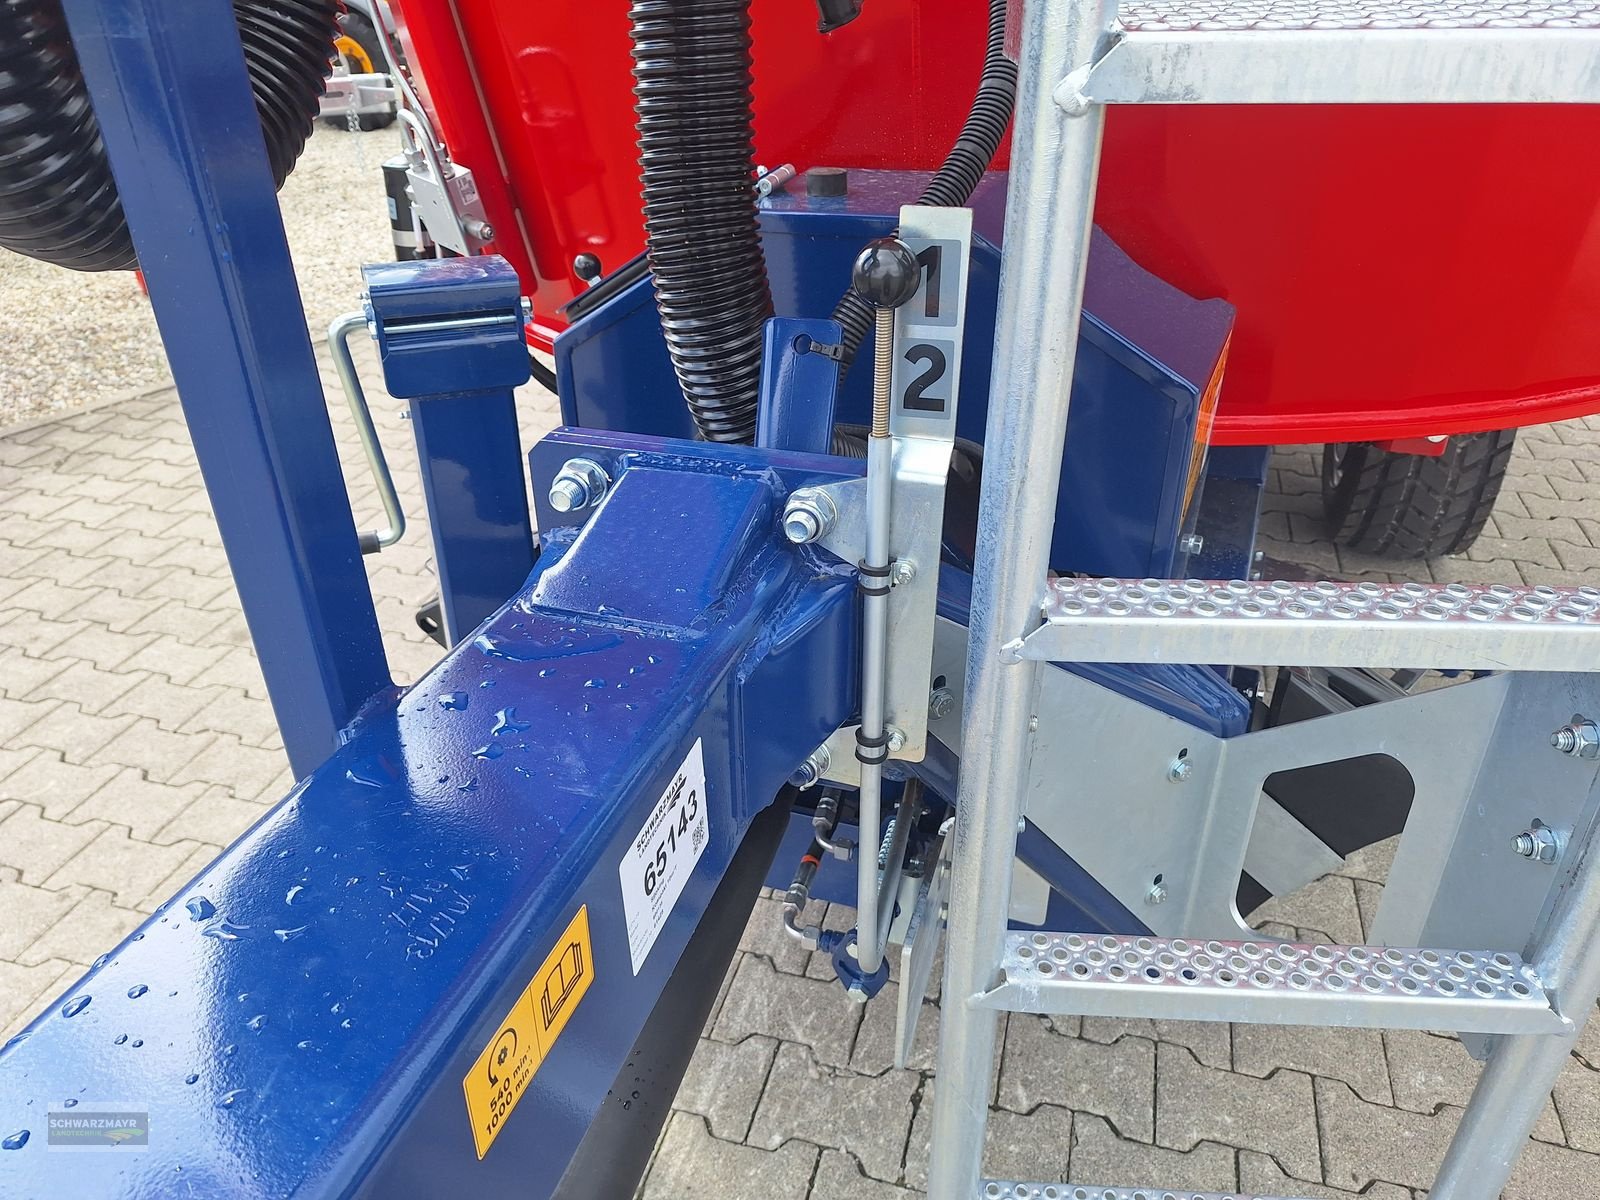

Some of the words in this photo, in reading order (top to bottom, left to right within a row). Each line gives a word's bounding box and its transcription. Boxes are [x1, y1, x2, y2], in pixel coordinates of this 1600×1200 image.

[915, 245, 943, 318] 1
[902, 343, 947, 412] 2
[636, 772, 683, 851] SCHWARZMAYR
[643, 789, 698, 897] 65143
[485, 1091, 513, 1136] 1000
[489, 1077, 511, 1113] 540
